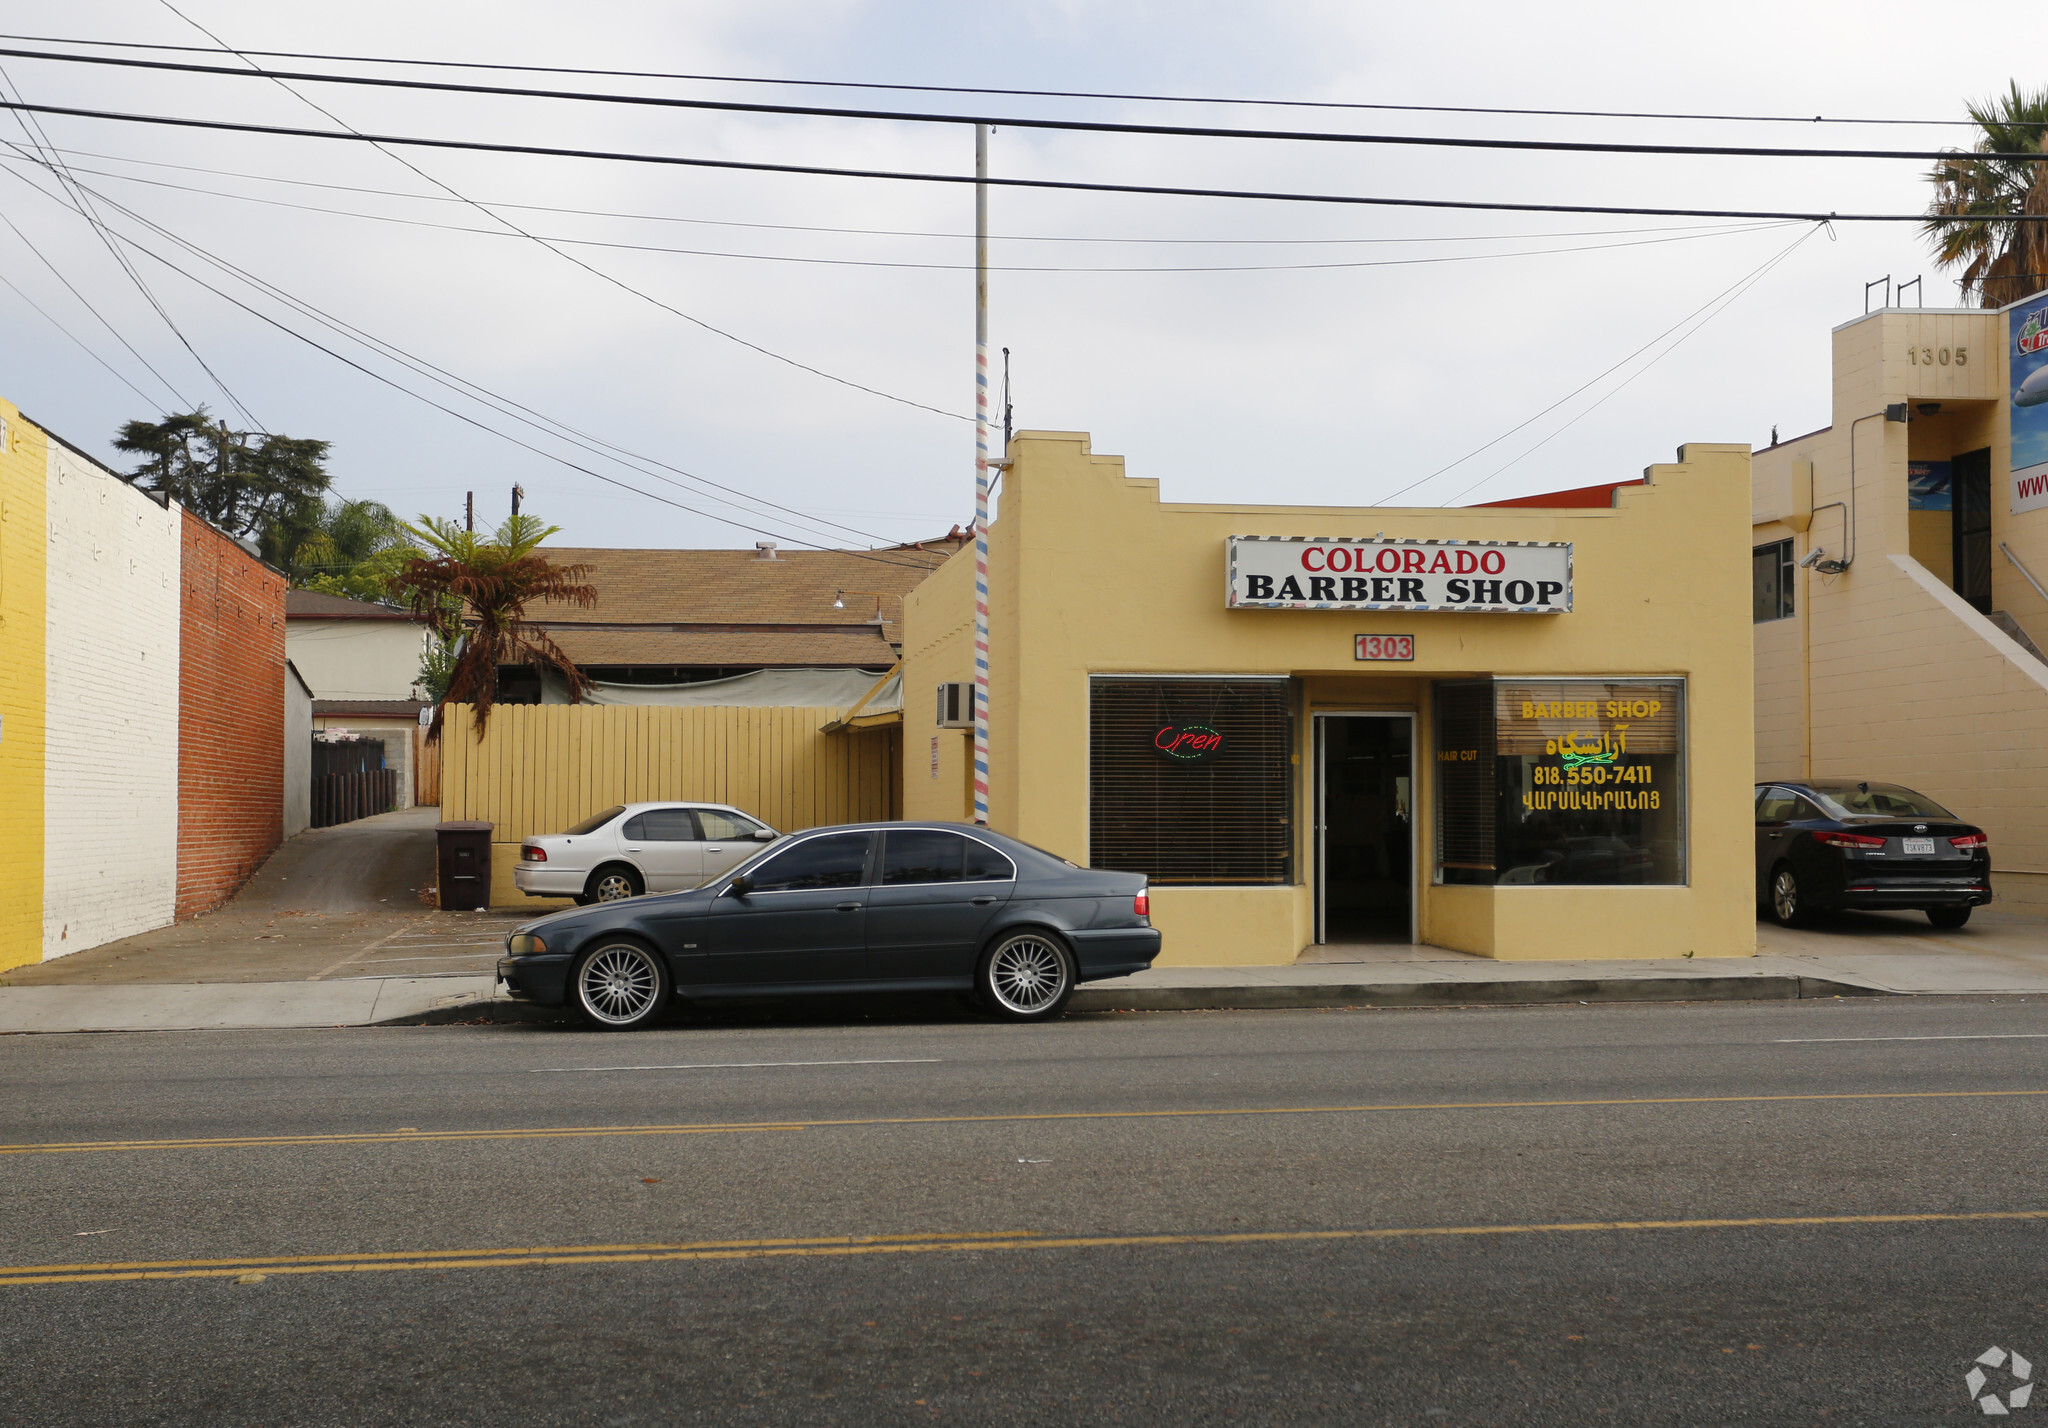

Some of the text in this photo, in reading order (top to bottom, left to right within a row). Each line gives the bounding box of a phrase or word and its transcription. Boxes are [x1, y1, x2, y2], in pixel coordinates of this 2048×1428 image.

[1907, 346, 1968, 366] 1305
[1301, 547, 1506, 575] COLORADO
[1245, 574, 1563, 605] BARBER SHOP
[1357, 636, 1412, 660] 1303
[1522, 700, 1661, 719] BARBER SHOP
[1155, 726, 1222, 752] Open
[1438, 750, 1478, 761] HAIR CUT
